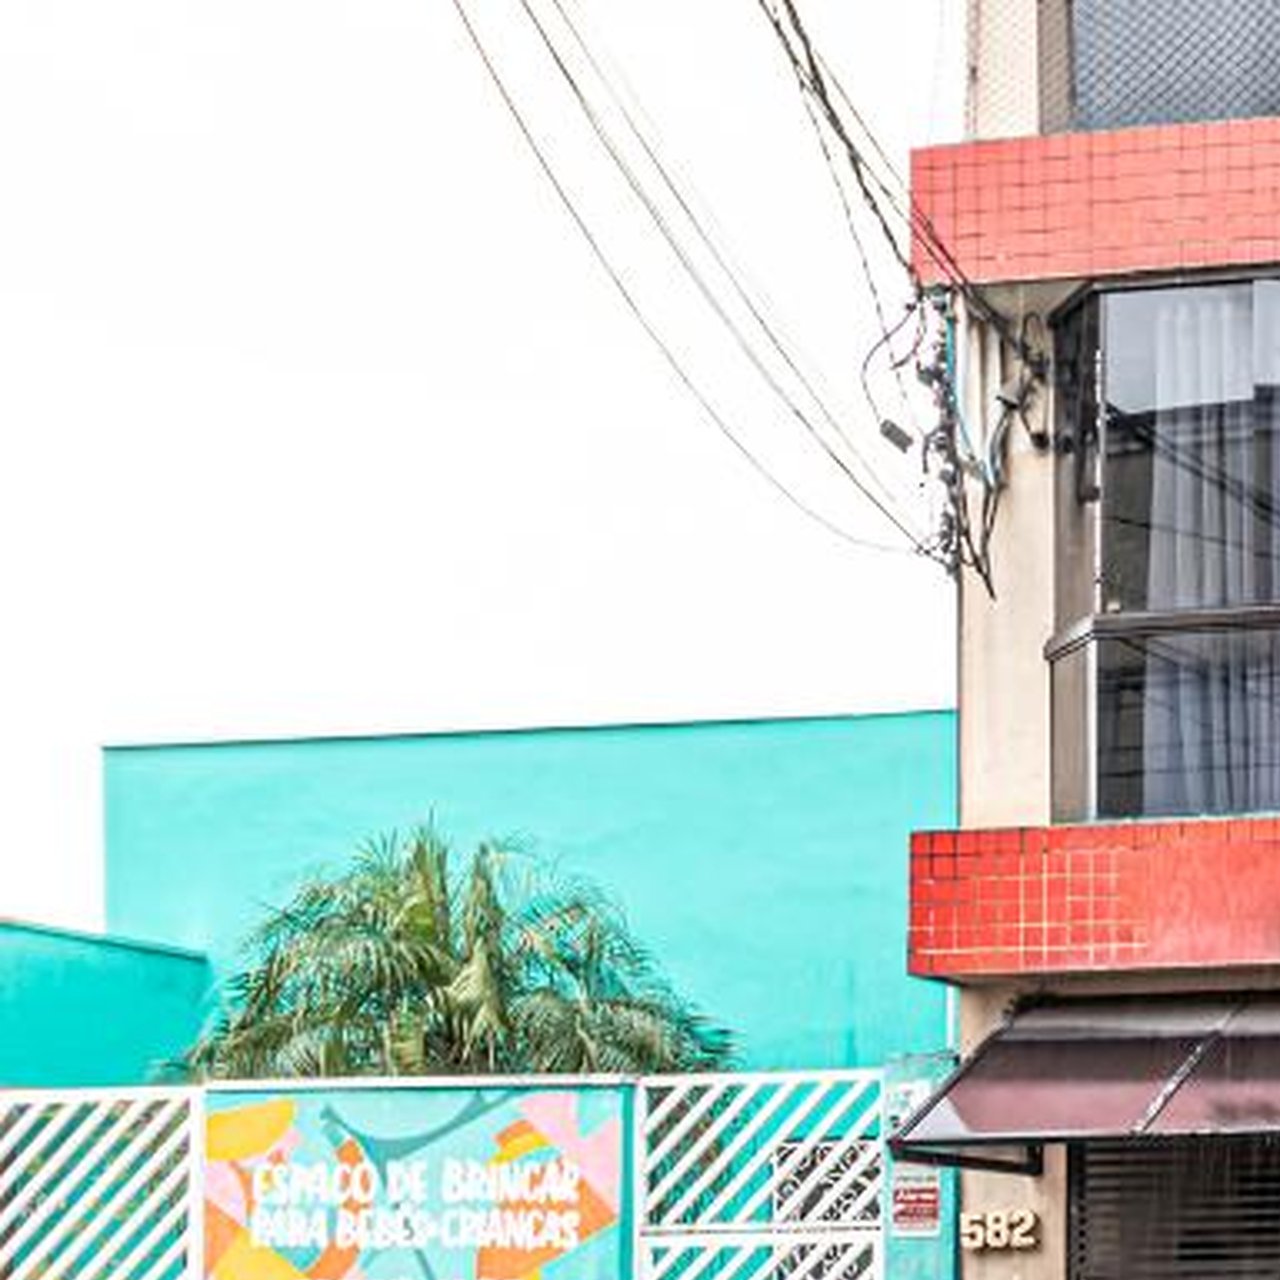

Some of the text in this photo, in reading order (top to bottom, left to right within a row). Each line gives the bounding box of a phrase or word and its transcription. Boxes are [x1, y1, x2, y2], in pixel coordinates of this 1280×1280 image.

[386, 1161, 427, 1201] DE
[442, 1160, 580, 1201] BRINCAR
[250, 1208, 328, 1250] PARA
[960, 1210, 1036, 1249] 582
